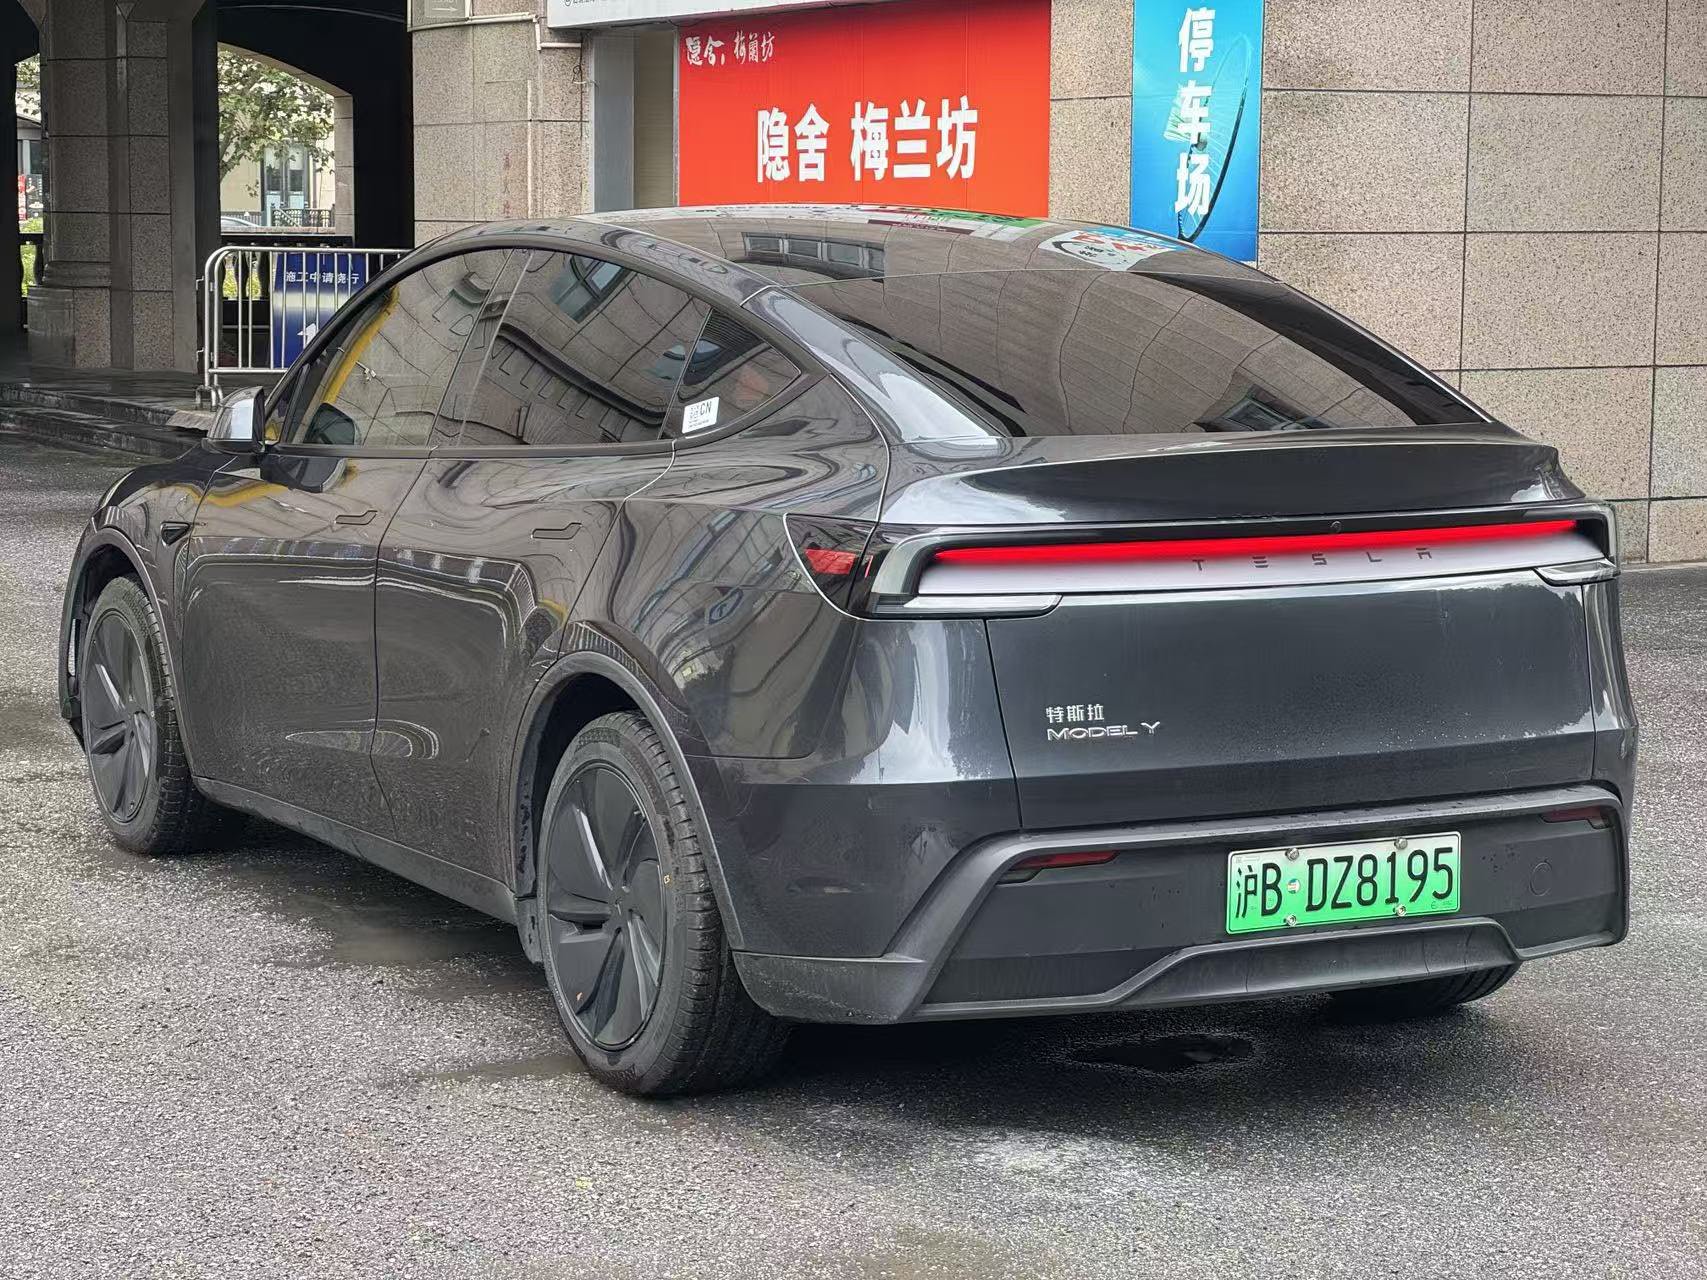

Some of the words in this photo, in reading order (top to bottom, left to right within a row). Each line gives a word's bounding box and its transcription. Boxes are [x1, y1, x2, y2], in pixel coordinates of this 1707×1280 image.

[1174, 7, 1216, 216] 停车场
[757, 103, 829, 183] 隱舍
[850, 95, 978, 182] 梅兰坊
[700, 401, 712, 415] CN
[1192, 547, 1432, 571] TESLA
[1045, 703, 1105, 724] 特斯拉
[1046, 724, 1138, 741] MODEL
[1140, 721, 1161, 735] Y
[1235, 861, 1283, 919] 沪B
[1305, 846, 1454, 913] DZ8195
